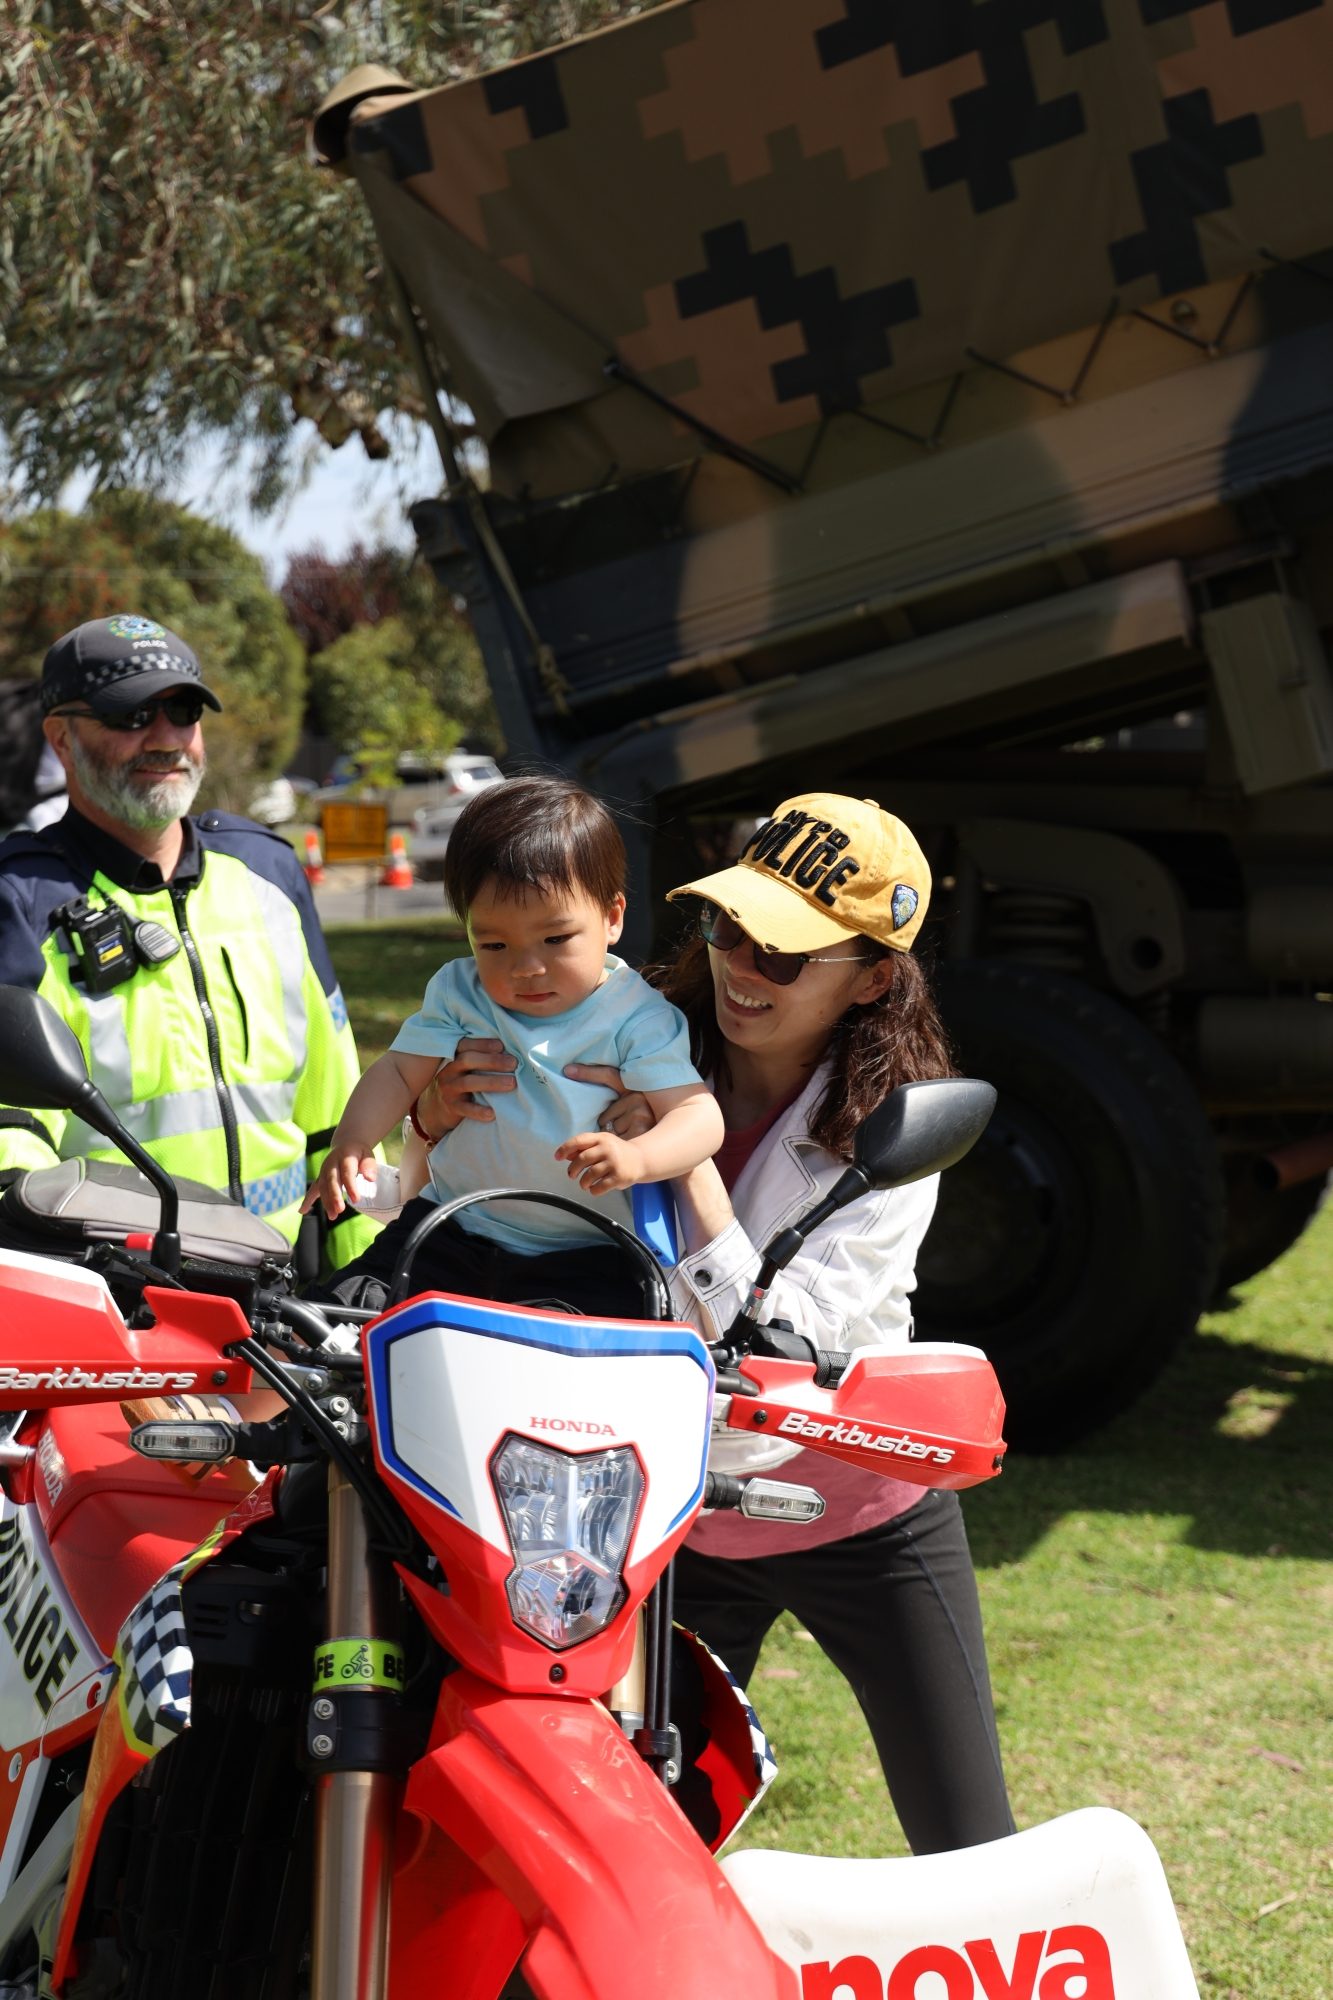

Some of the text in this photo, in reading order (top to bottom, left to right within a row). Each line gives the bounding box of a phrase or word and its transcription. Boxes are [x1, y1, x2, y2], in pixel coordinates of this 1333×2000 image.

[781, 809, 851, 851] NYPD
[741, 817, 860, 907] POLICE
[0, 1366, 197, 1390] Barkbusters
[529, 1416, 617, 1437] HONDA
[777, 1411, 956, 1464] Barkbusters
